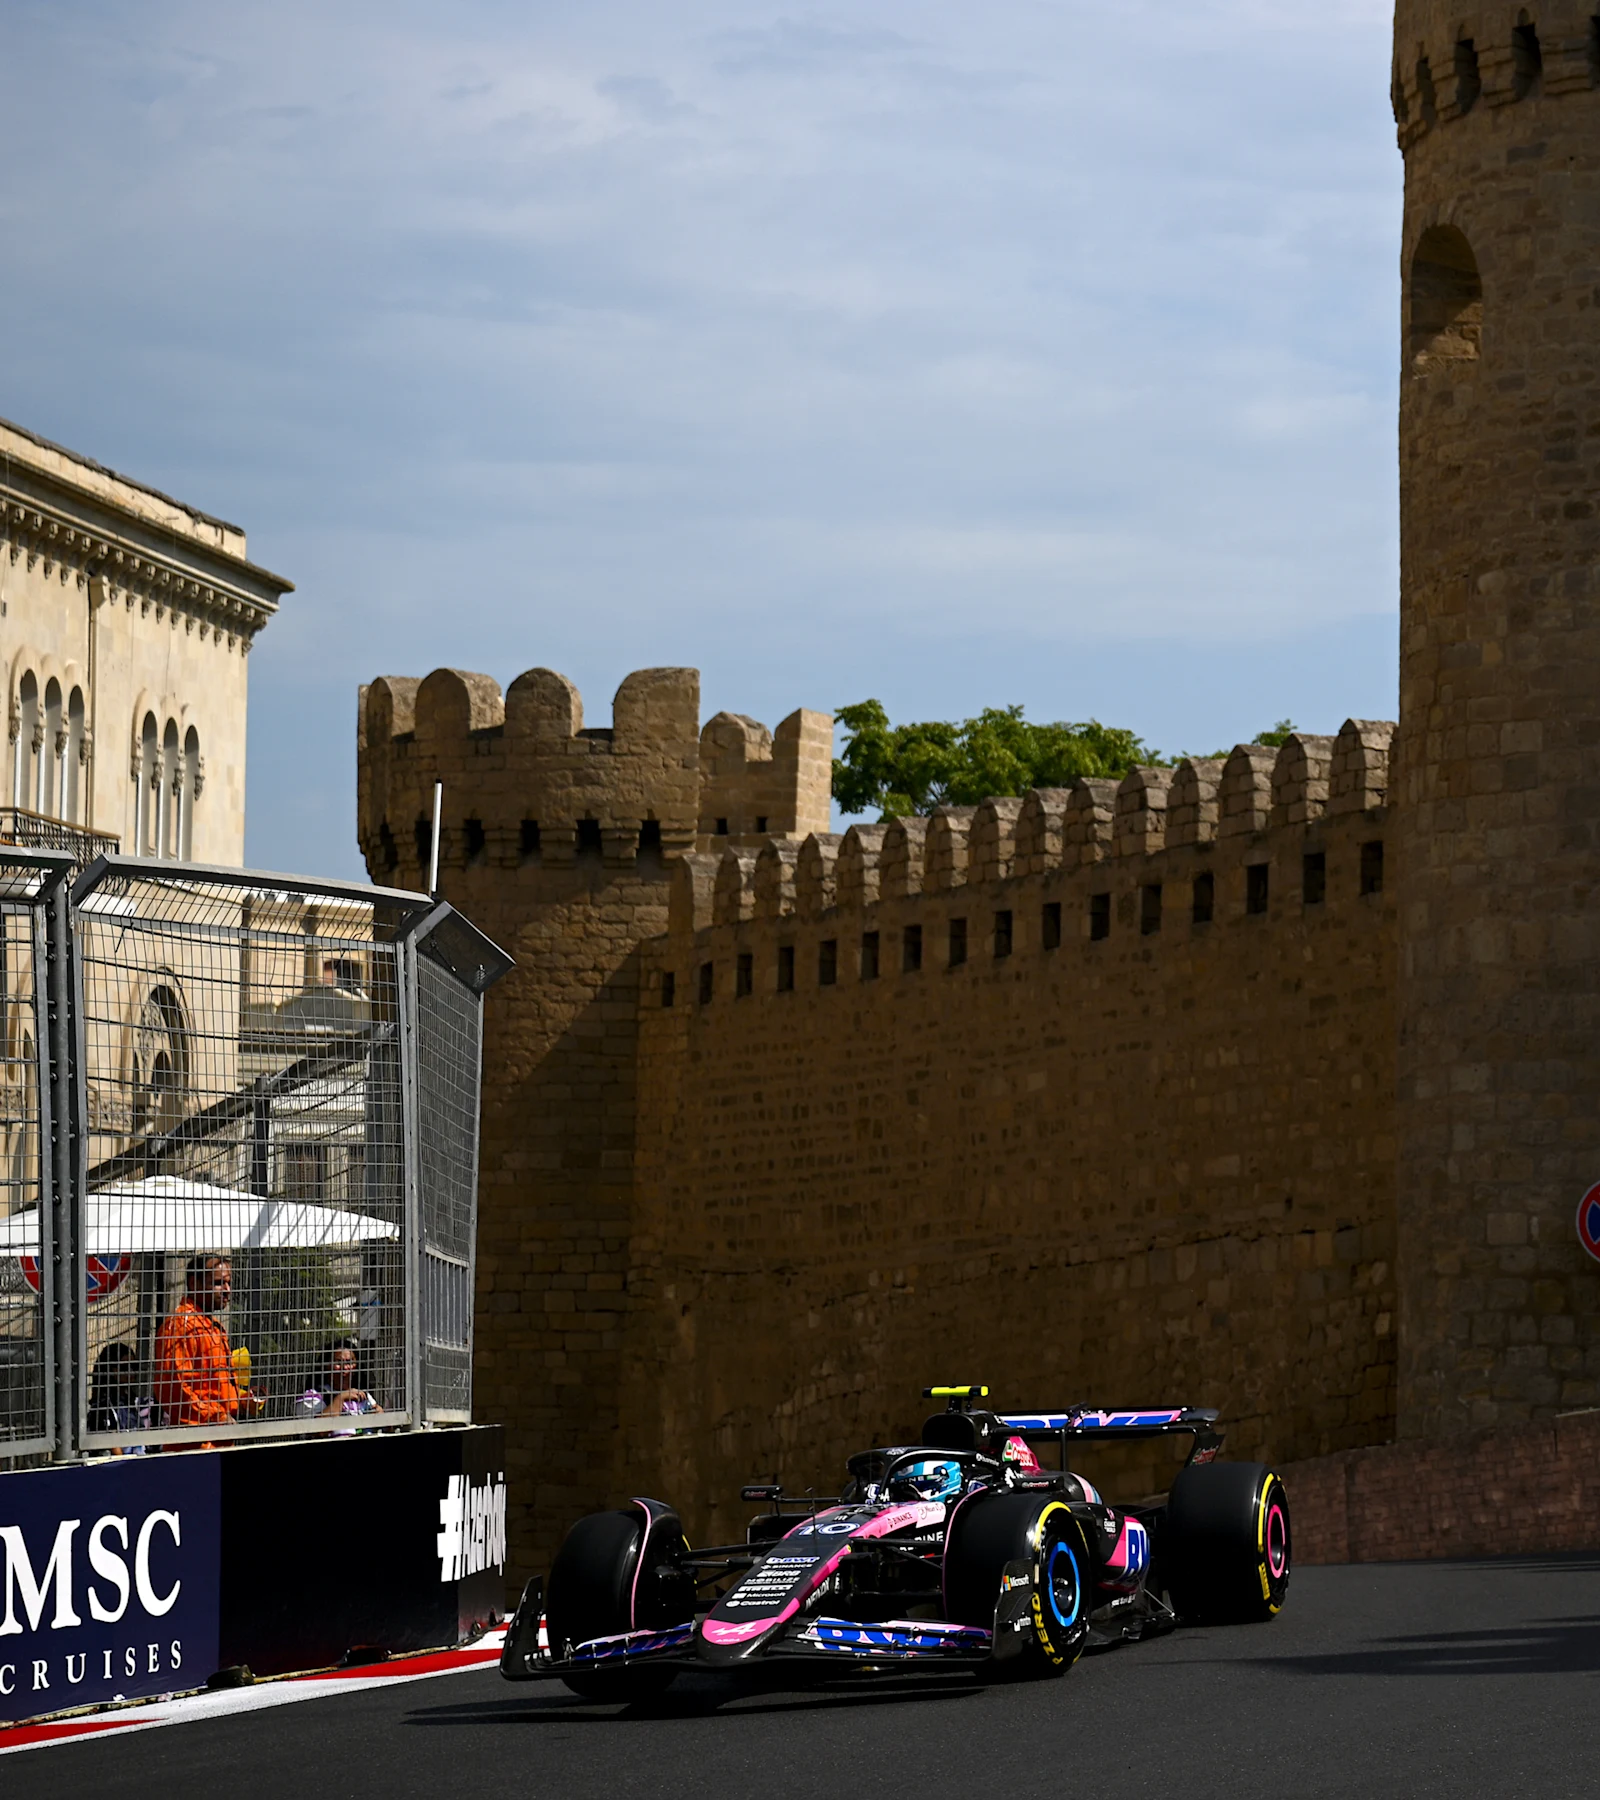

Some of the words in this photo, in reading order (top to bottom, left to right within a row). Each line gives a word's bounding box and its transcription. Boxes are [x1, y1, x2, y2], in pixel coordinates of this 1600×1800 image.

[799, 1522, 860, 1536] 10
[892, 1512, 913, 1525] BINANCE
[0, 1510, 181, 1636] MSC
[1032, 1592, 1055, 1656] ZERO
[0, 1640, 181, 1694] CRUISES
